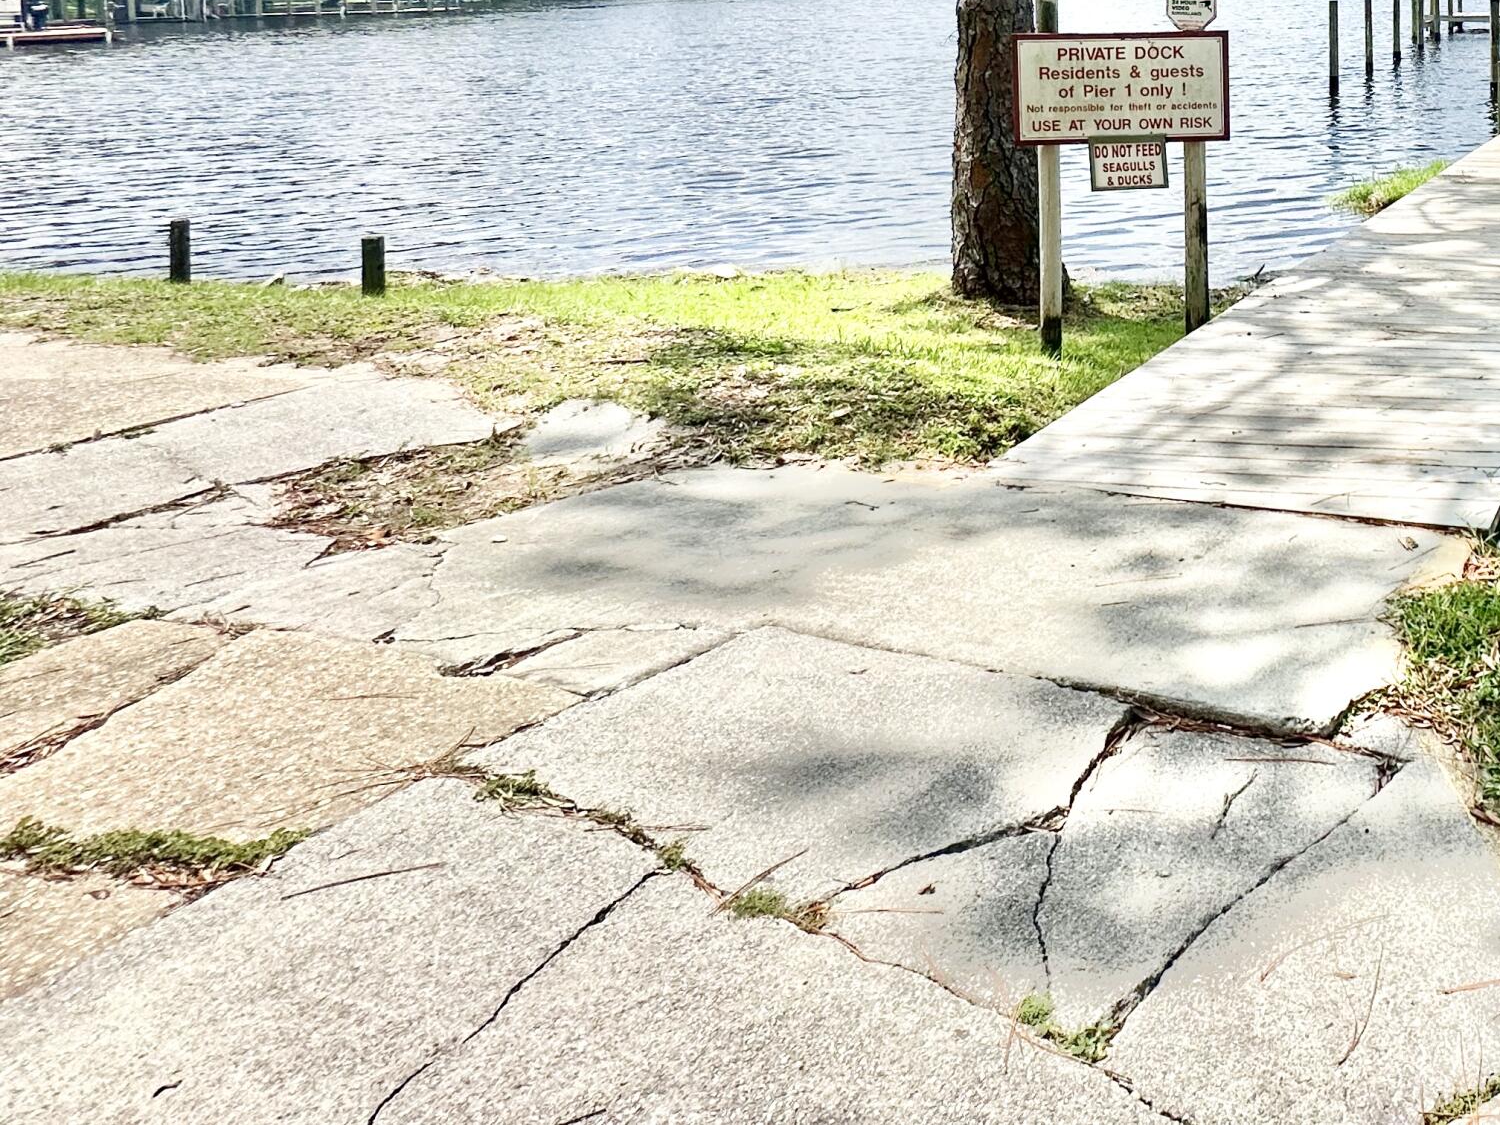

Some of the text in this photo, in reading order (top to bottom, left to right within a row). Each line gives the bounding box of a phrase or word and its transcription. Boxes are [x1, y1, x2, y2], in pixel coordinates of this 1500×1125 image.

[1057, 46, 1184, 61] PRIVATE DOCK
[1039, 64, 1204, 80] Residents & guests
[1058, 82, 1186, 99] of Pier 1 only !
[1026, 105, 1044, 113] Not
[1049, 104, 1105, 113] responsible
[1110, 104, 1123, 112] for
[1129, 103, 1151, 111] theft
[1171, 101, 1217, 110] accidents
[1032, 117, 1213, 132] USE AT YOUR OWN RISK
[1094, 144, 1161, 158] DO NOT FEED
[1103, 161, 1155, 172] SEAGULLS
[1107, 174, 1152, 186] & DUCKS
